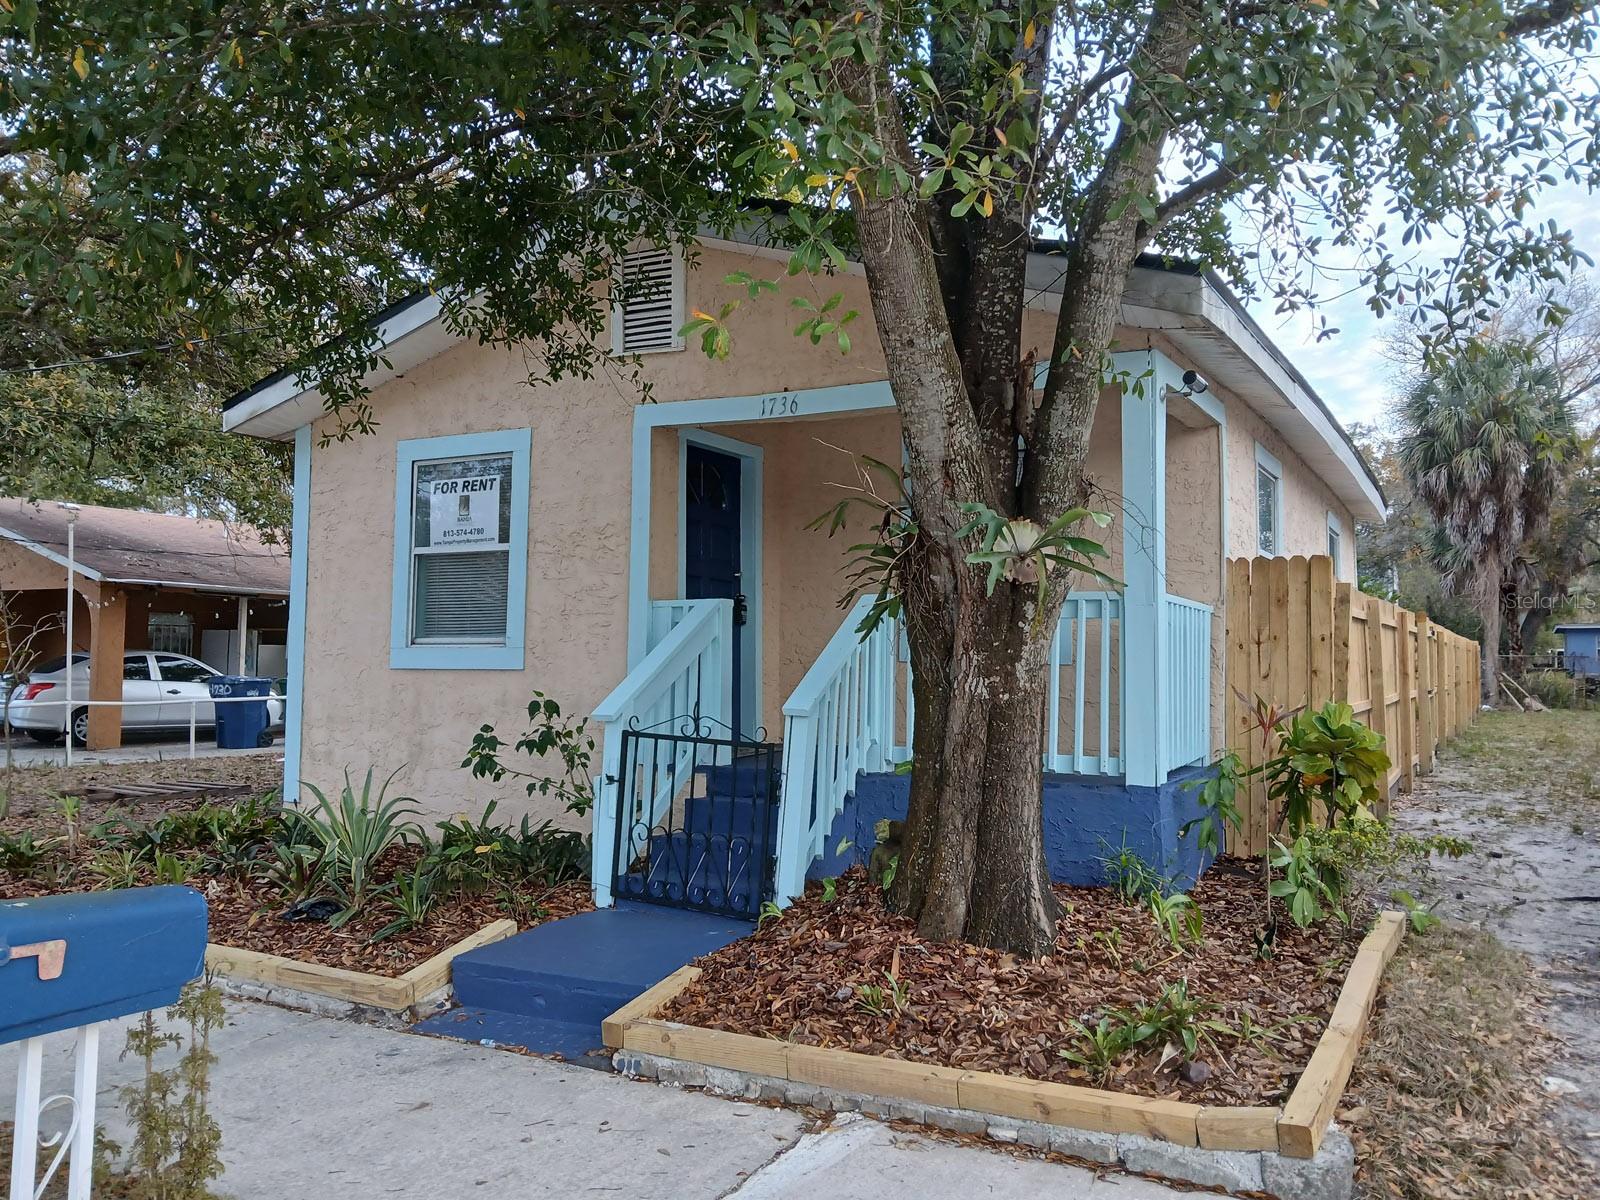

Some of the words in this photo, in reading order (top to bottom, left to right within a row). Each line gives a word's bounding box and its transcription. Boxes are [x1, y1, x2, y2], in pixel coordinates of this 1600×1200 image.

[761, 393, 798, 416] 1736
[433, 481, 458, 495] FOR
[462, 478, 496, 492] RENT
[443, 528, 484, 538] 813-574-4780
